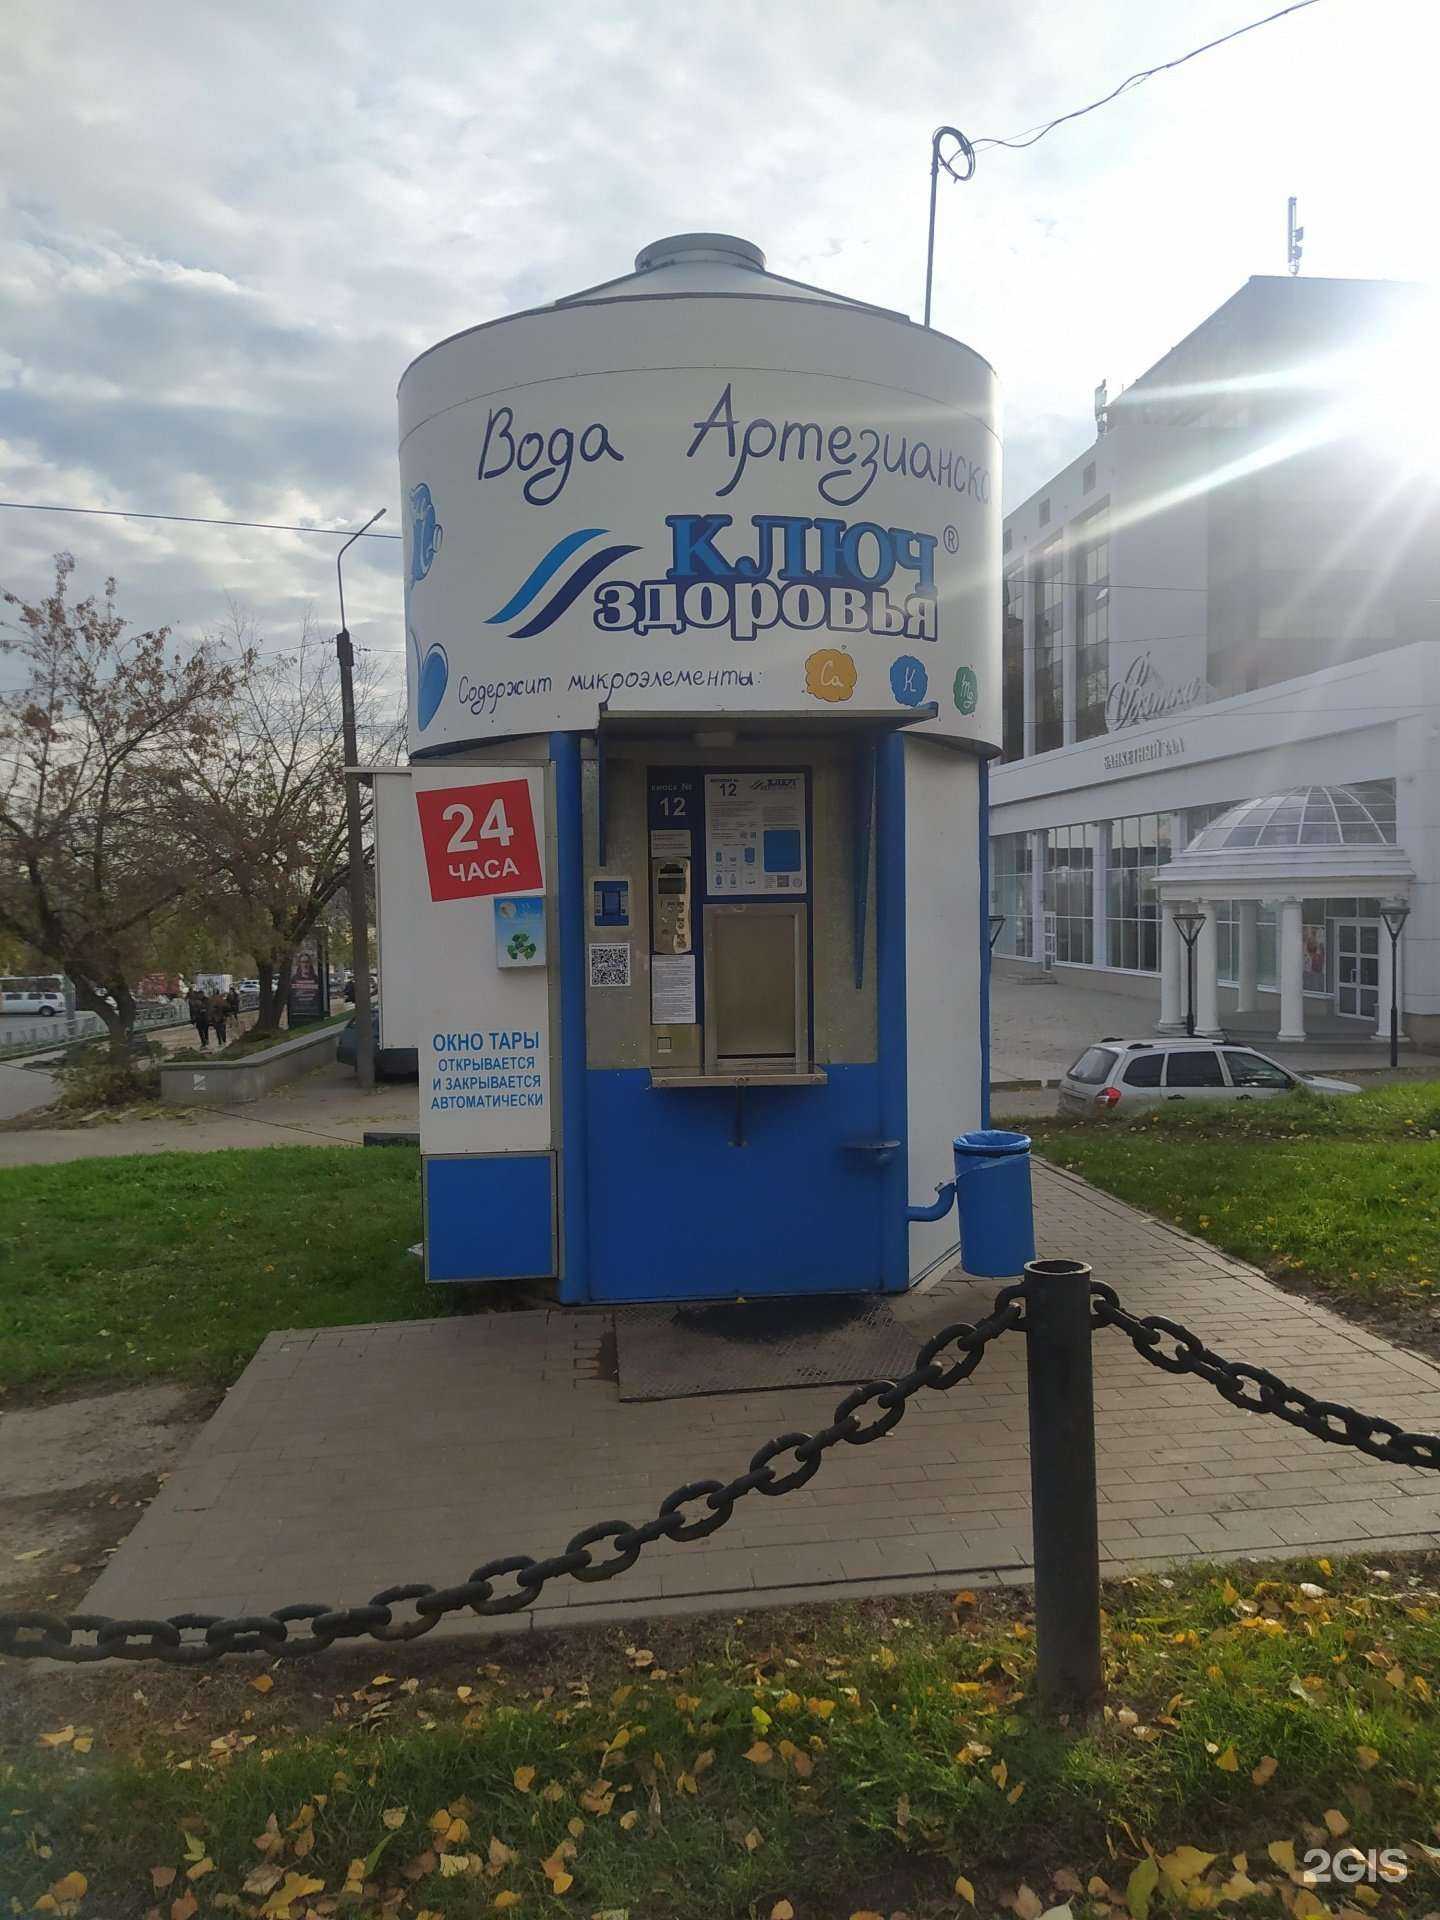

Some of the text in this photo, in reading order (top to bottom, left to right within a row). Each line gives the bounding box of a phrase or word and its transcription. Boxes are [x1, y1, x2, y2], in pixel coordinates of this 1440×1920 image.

[478, 407, 624, 506] Вода
[458, 670, 763, 715] Содержит микроэлементы:
[719, 783, 737, 797] 12
[660, 797, 688, 816] 12
[442, 798, 514, 853] 24
[448, 857, 520, 882] ЧАСА
[433, 1031, 539, 1052] ОКНО ТАРЫ
[438, 1056, 535, 1072] ОТКРЫВАЕТСЯ
[432, 1075, 541, 1091] И ЗАКРЫВАЕТСЯ
[431, 1093, 543, 1110] АВТОМАТИЧЕСКИ
